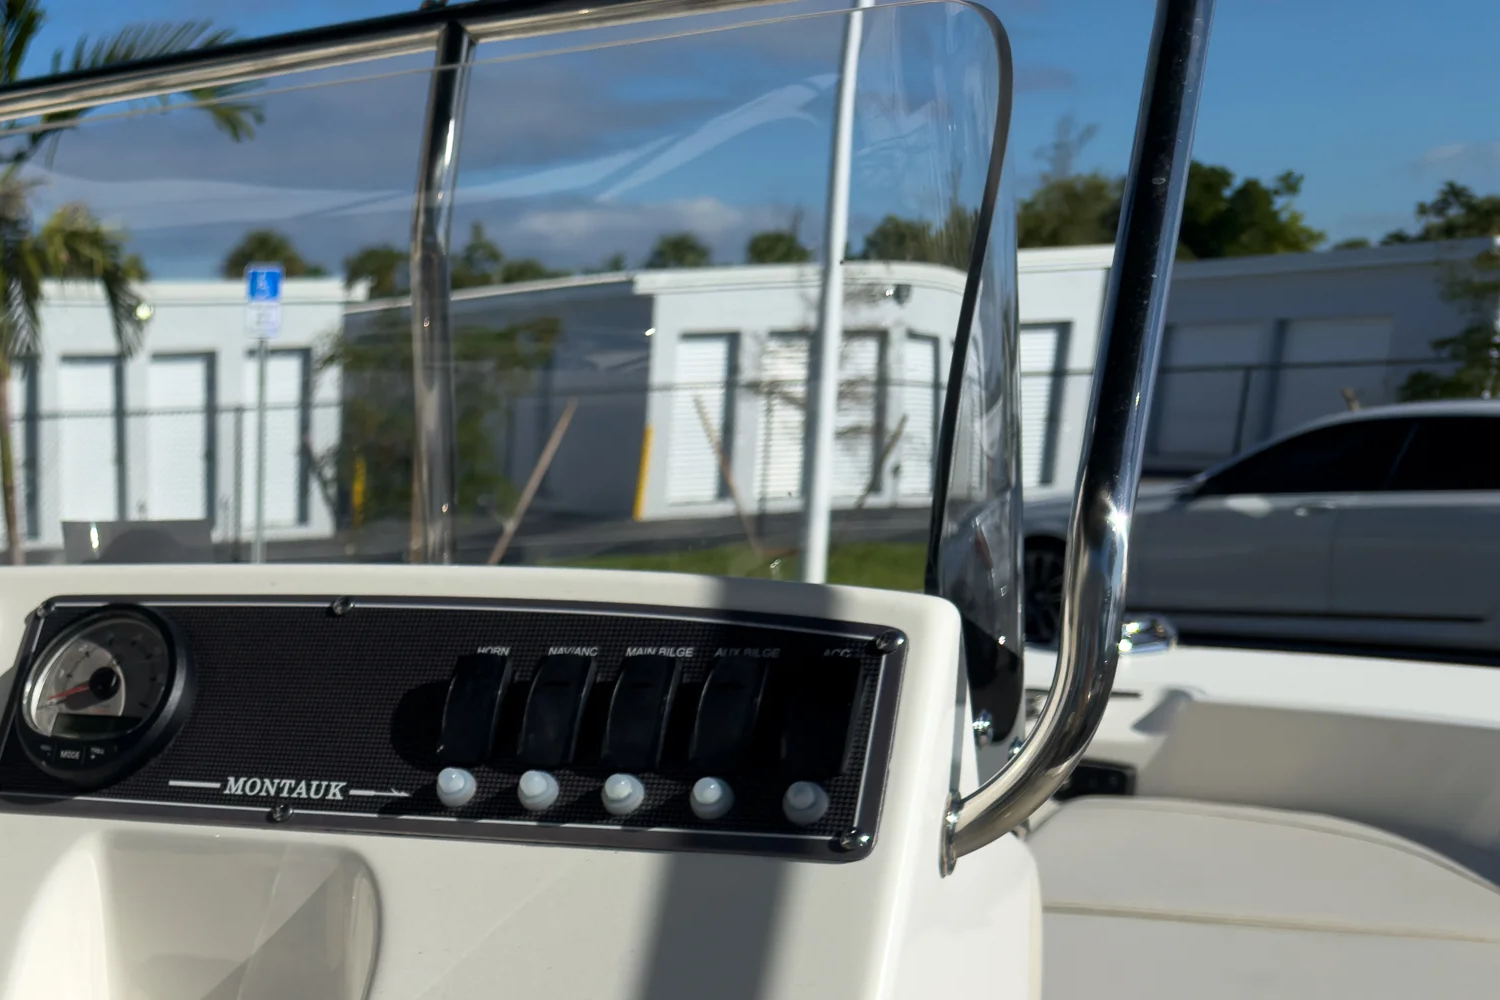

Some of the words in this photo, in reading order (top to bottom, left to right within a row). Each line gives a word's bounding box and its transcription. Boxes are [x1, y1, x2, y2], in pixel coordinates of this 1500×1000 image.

[625, 646, 656, 657] MAIN
[657, 646, 694, 658] BILGE
[223, 776, 347, 801] MONTAUK
